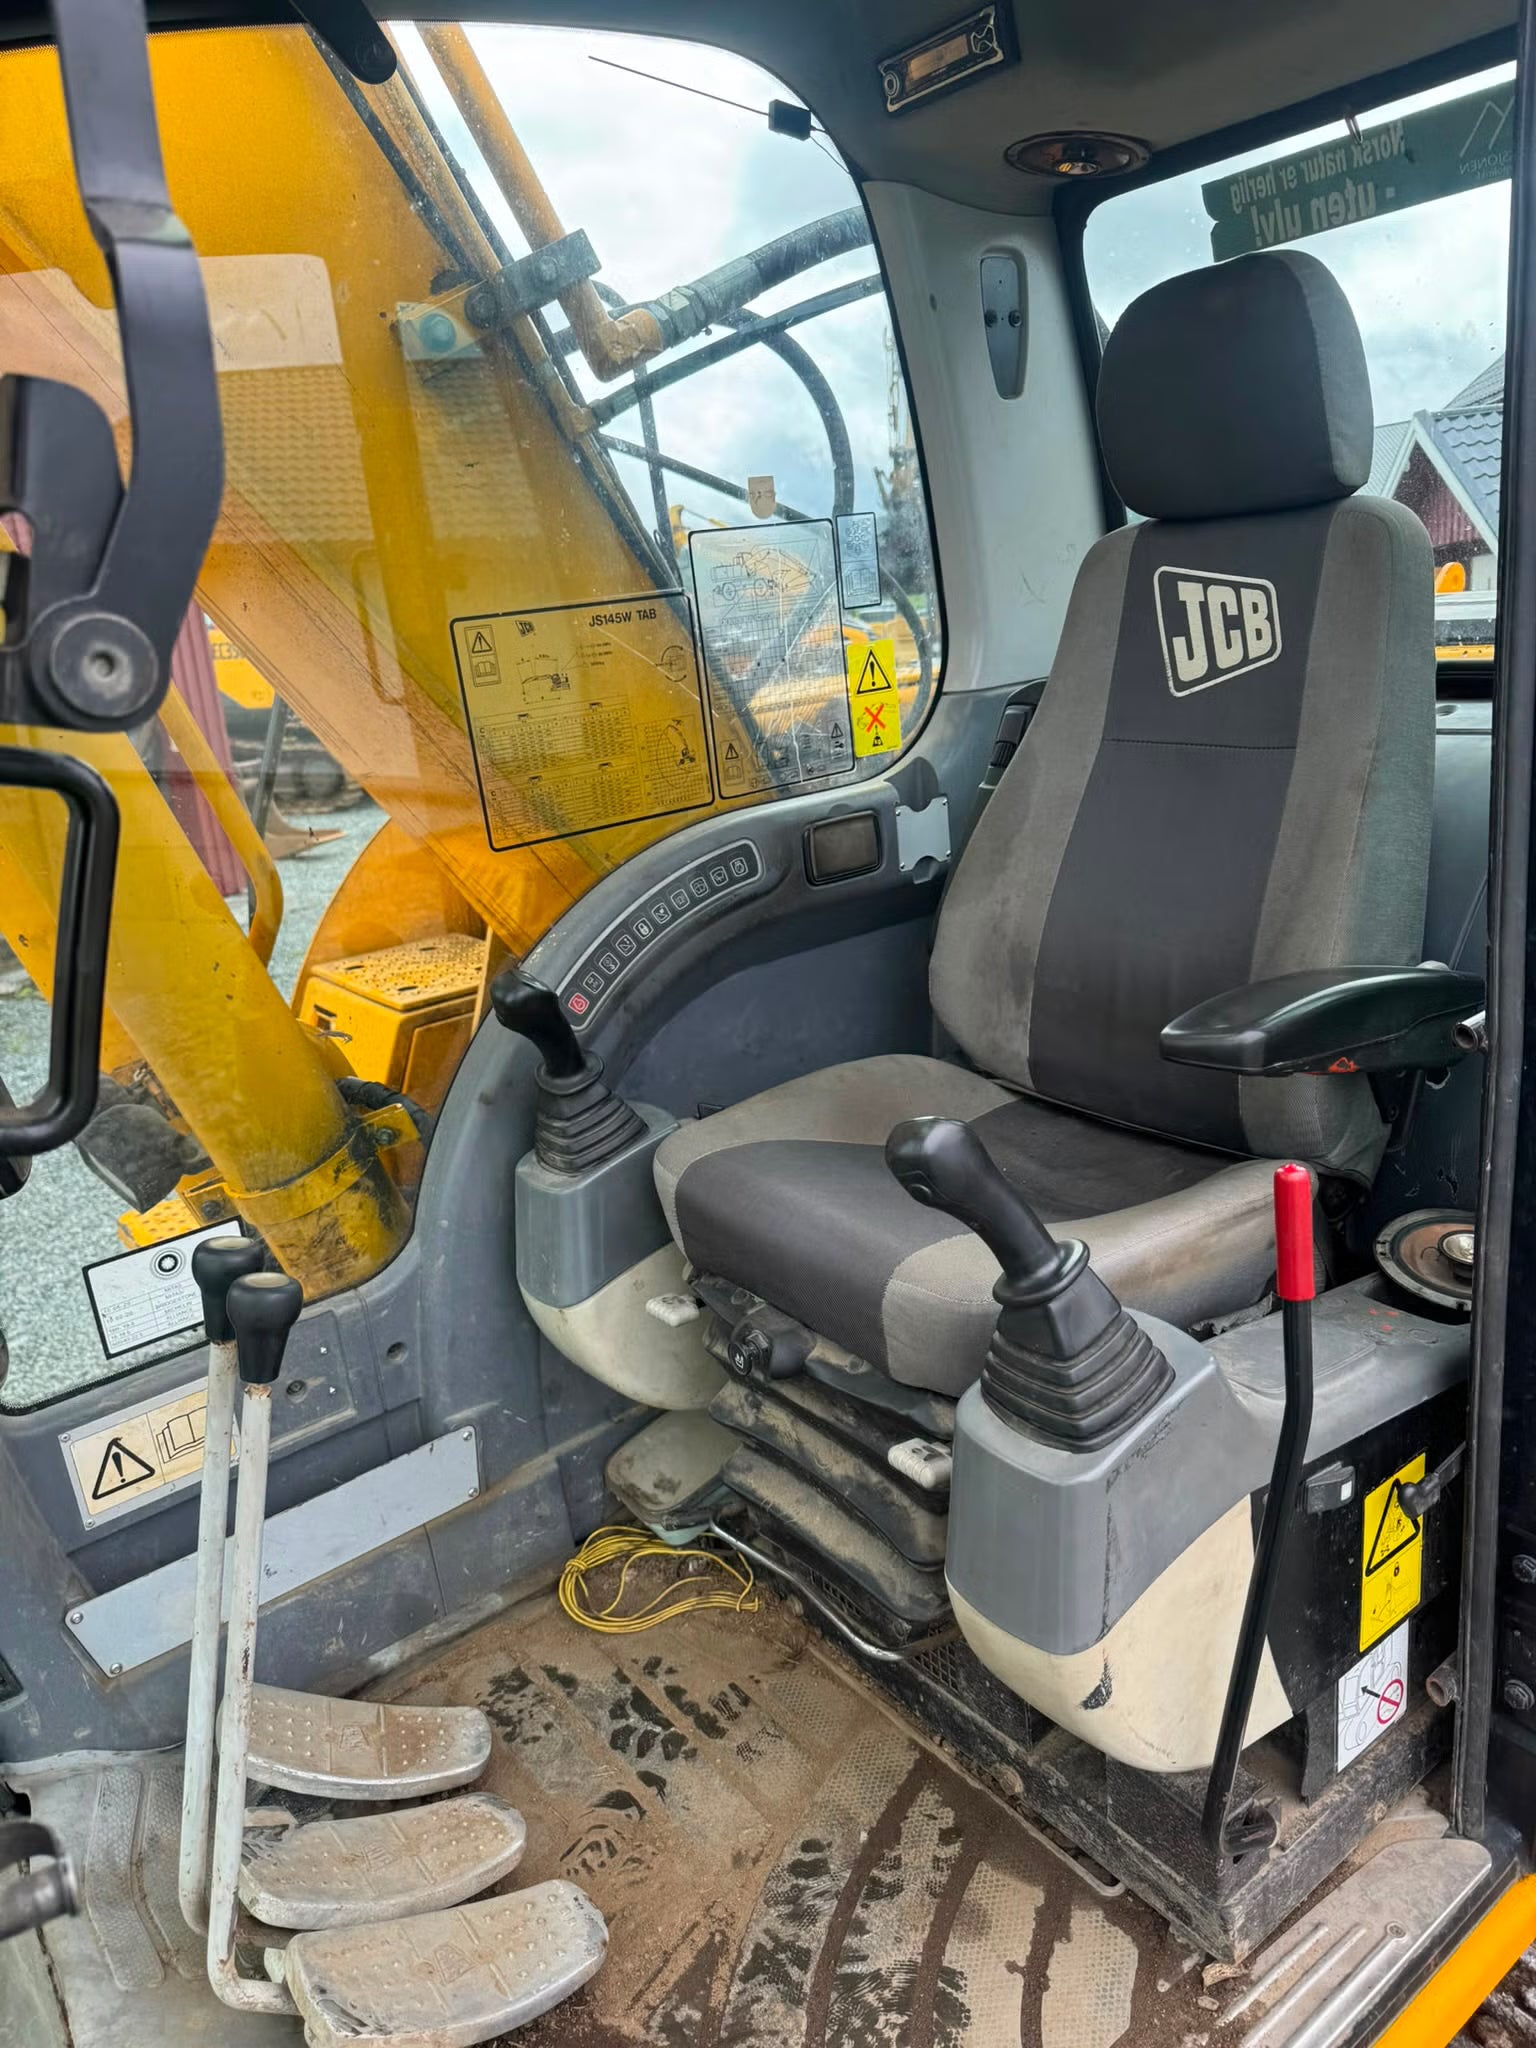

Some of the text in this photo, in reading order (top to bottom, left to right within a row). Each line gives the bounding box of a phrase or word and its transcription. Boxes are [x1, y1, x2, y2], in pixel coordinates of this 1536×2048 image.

[588, 608, 657, 628] JS145W TAB
[1172, 581, 1273, 683] JCB
